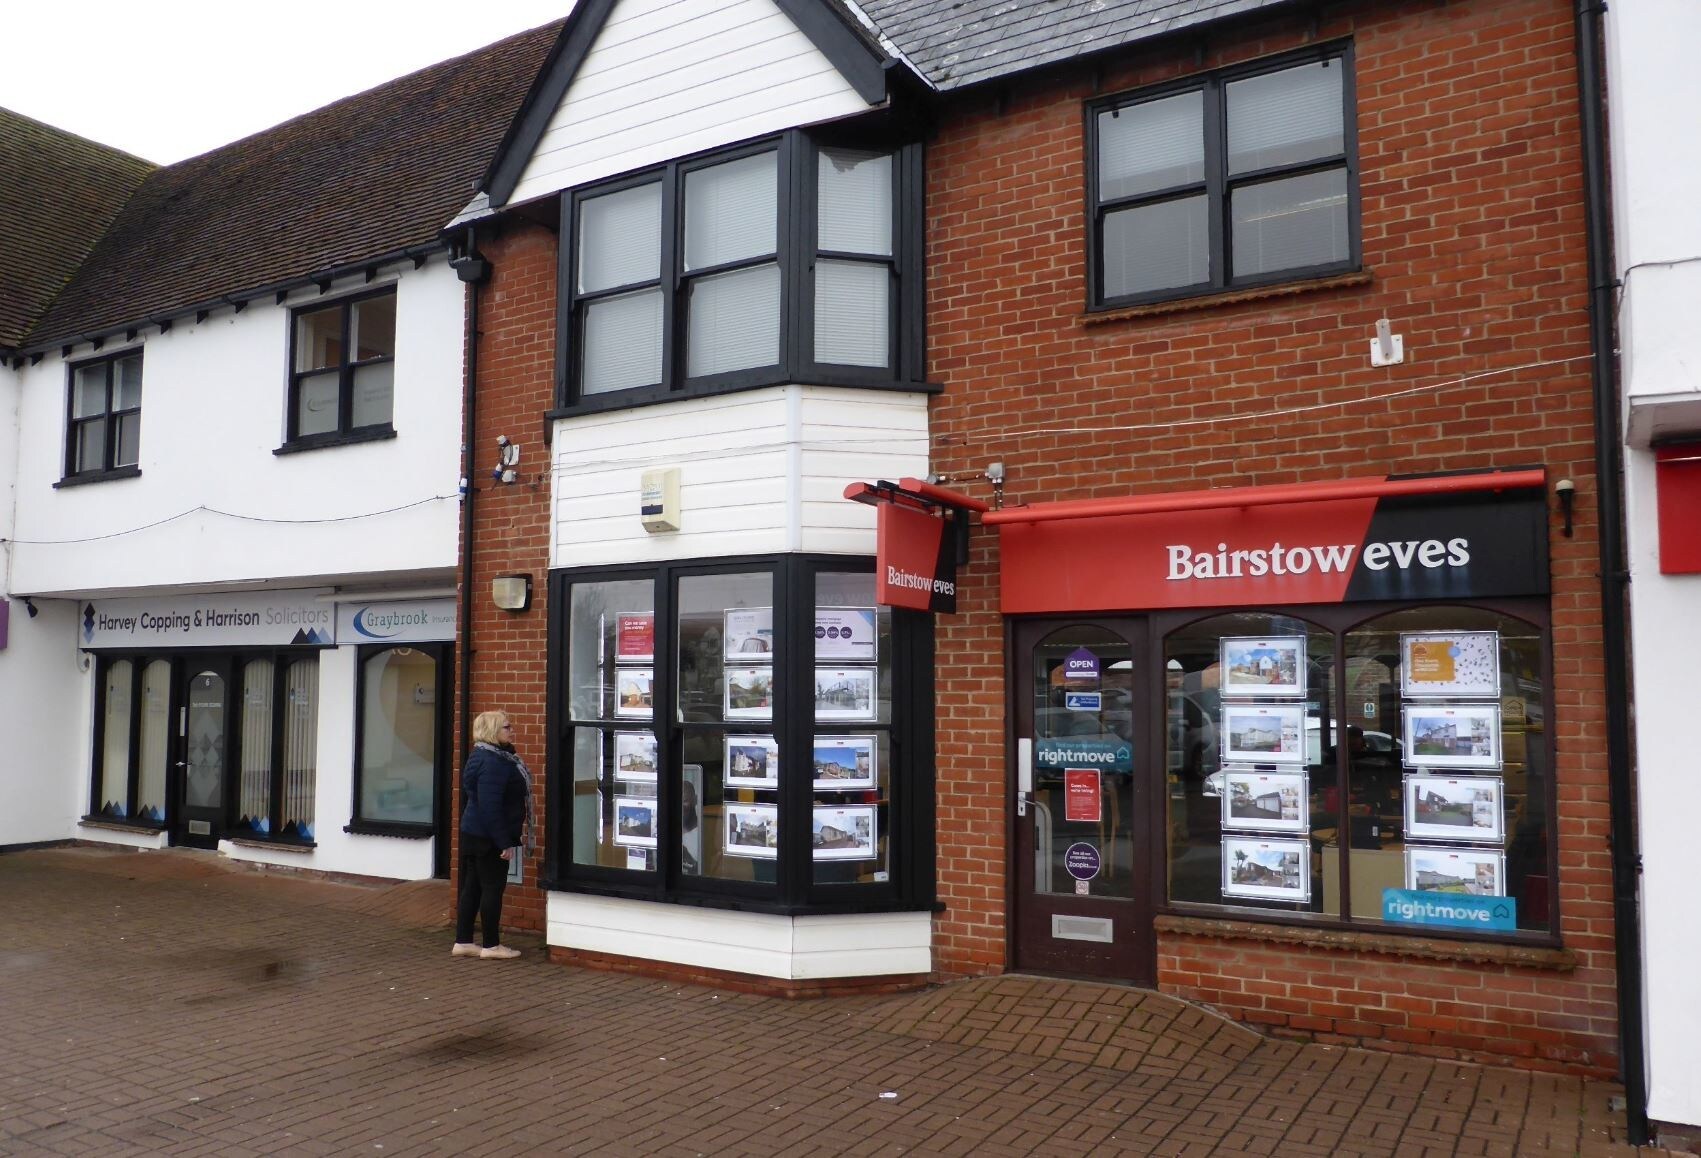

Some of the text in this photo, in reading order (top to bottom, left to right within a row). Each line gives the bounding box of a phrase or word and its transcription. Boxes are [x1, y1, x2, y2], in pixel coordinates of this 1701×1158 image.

[1166, 537, 1470, 580] Bairstow eves
[887, 565, 955, 596] Bairstow eves
[98, 606, 329, 634] Harvey Copping & Harrison Solicitors
[367, 609, 428, 630] Graybrook
[1069, 660, 1094, 668] OPEN
[205, 678, 210, 687] 6
[1038, 748, 1115, 765] rightmove
[1388, 899, 1490, 921] rightmove
